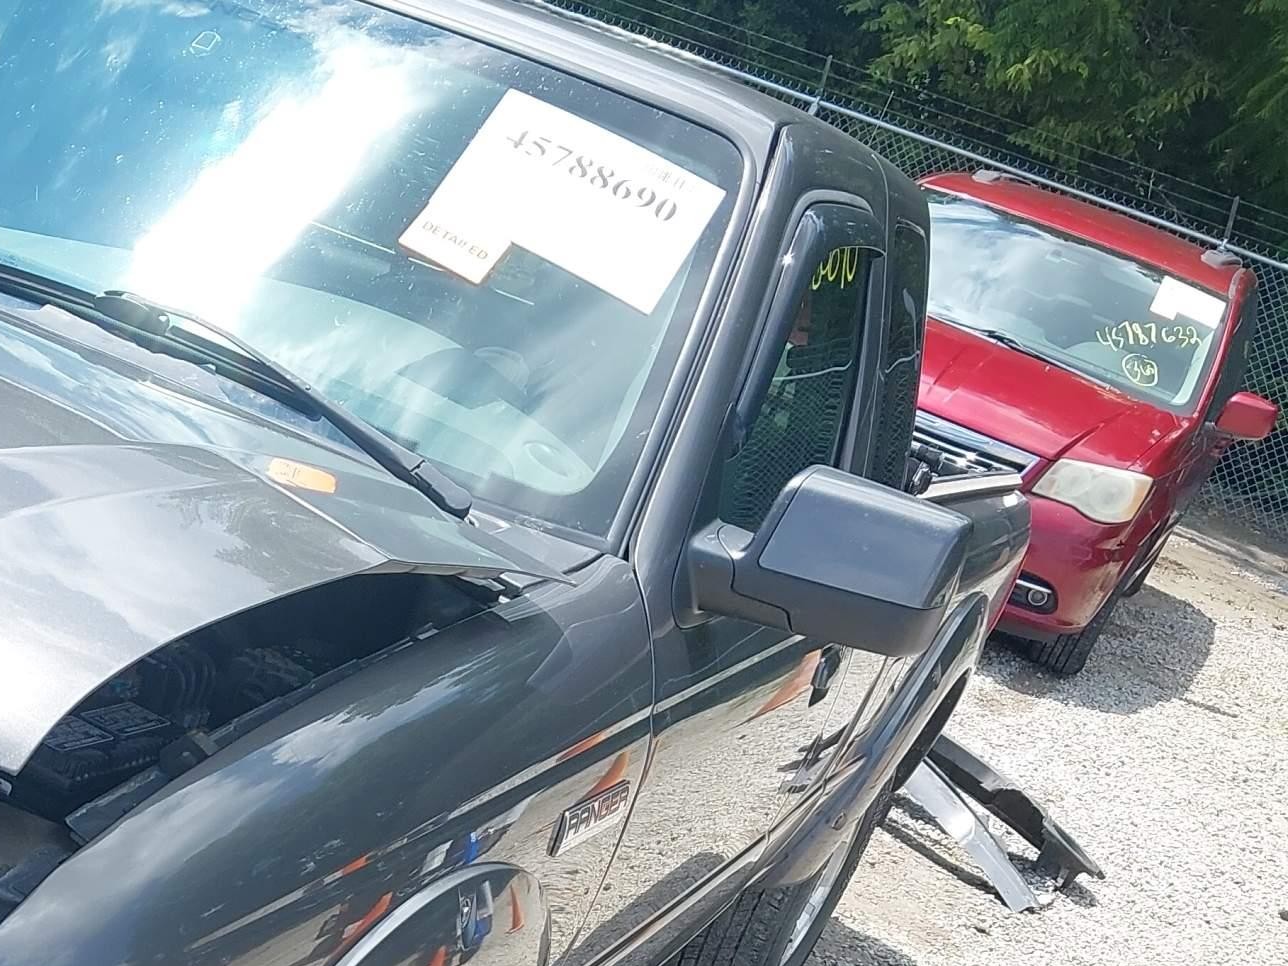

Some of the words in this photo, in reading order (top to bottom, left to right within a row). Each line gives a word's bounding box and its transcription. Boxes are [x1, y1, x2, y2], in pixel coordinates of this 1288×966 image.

[505, 129, 678, 222] 45788690
[421, 220, 489, 261] DETAILED
[562, 784, 631, 842] RANGER
